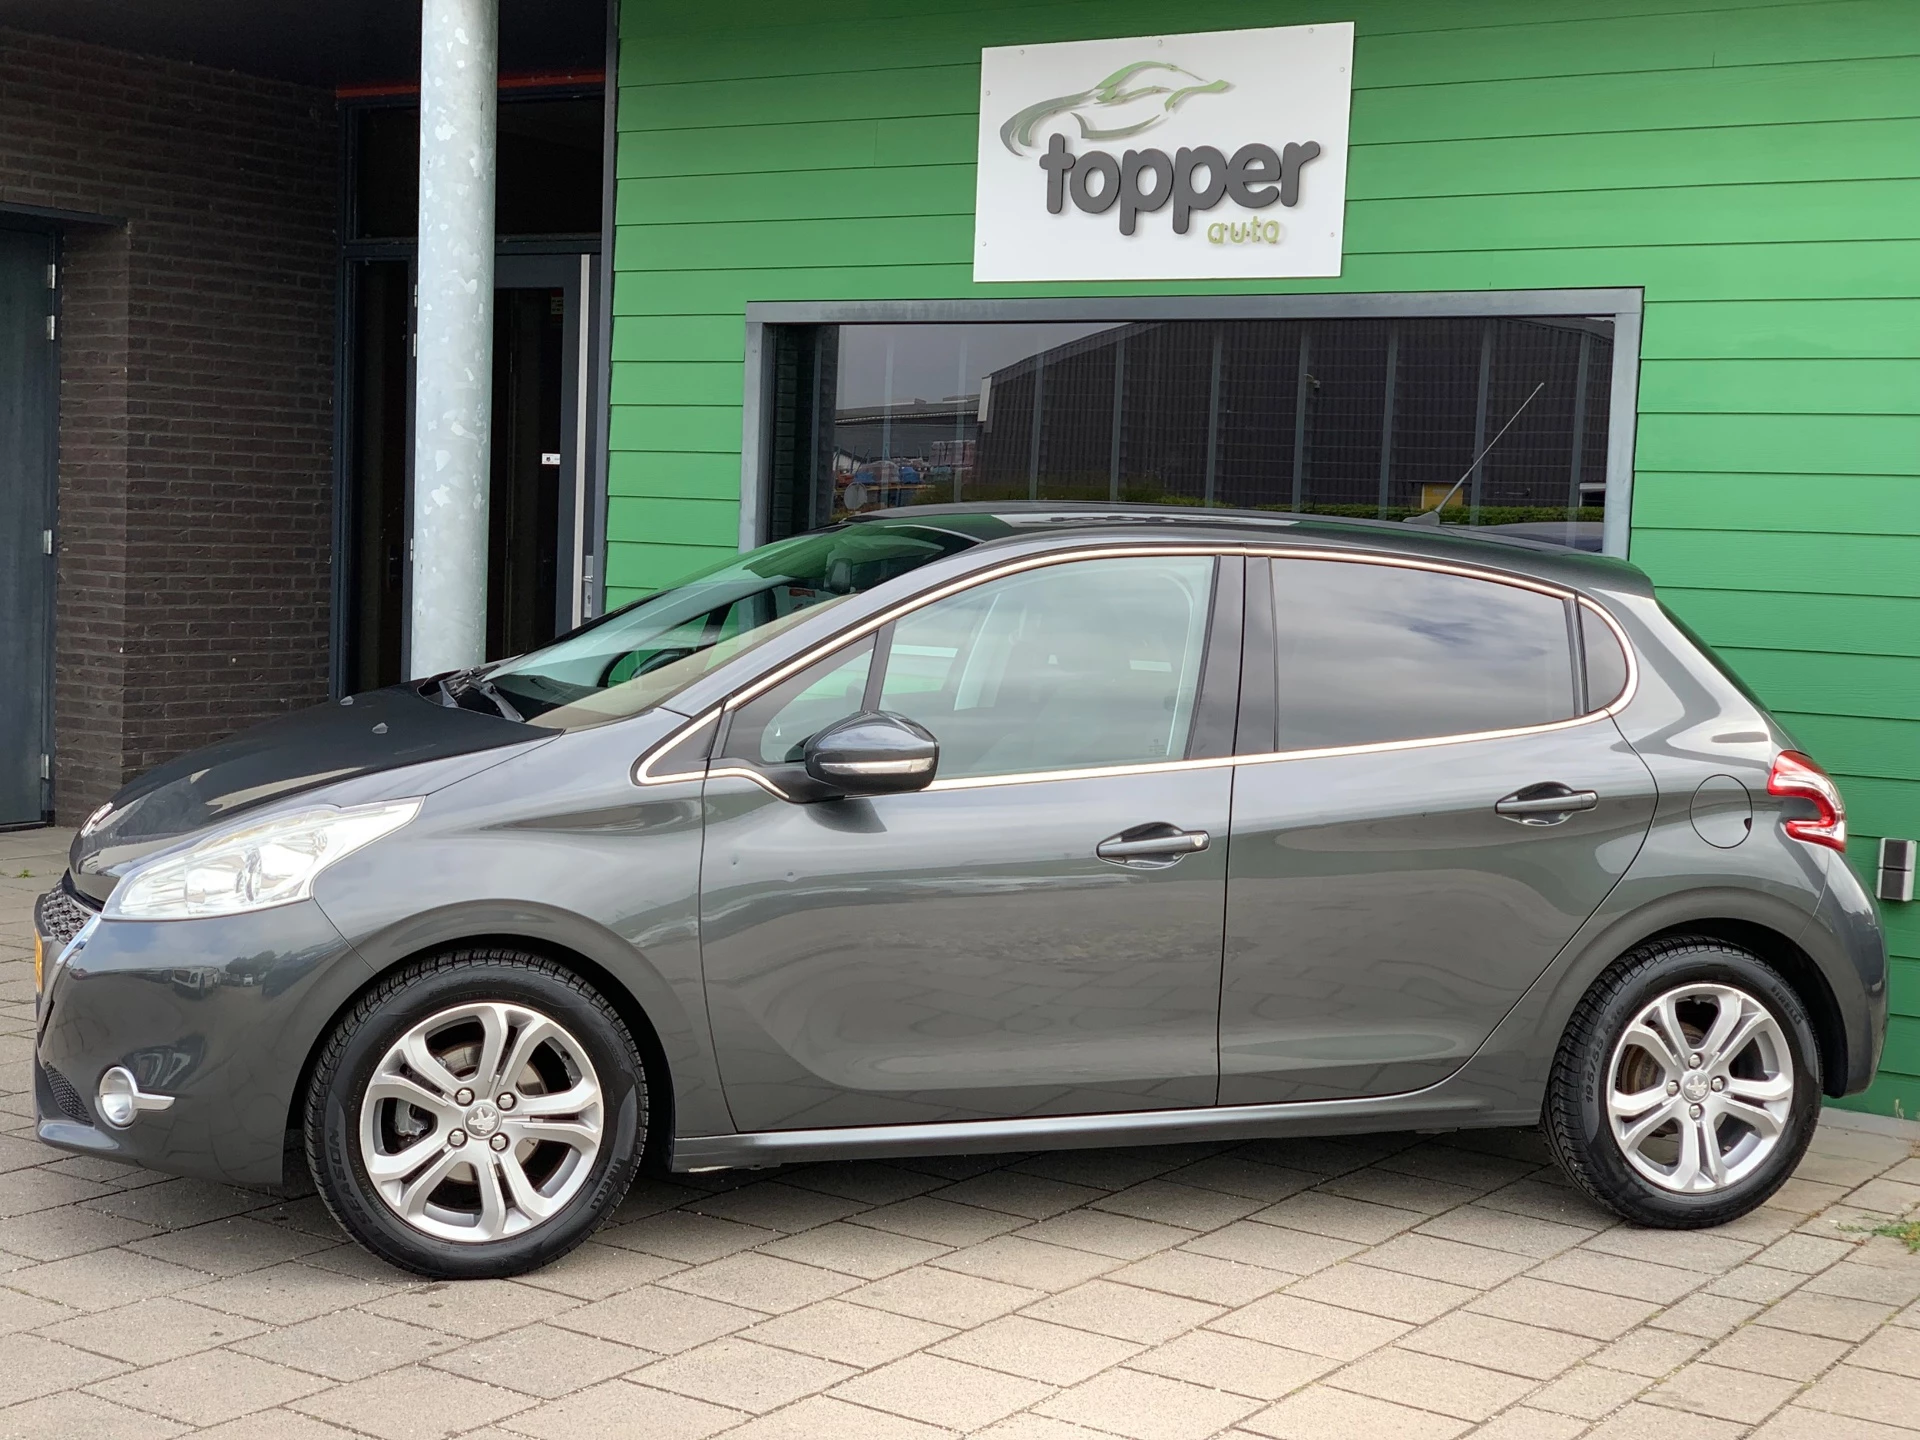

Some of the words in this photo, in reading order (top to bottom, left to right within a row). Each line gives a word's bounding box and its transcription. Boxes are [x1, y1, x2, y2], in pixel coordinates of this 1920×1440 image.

[1039, 133, 1320, 236] topper
[1207, 216, 1281, 245] auto
[328, 1127, 373, 1225] SEASON
